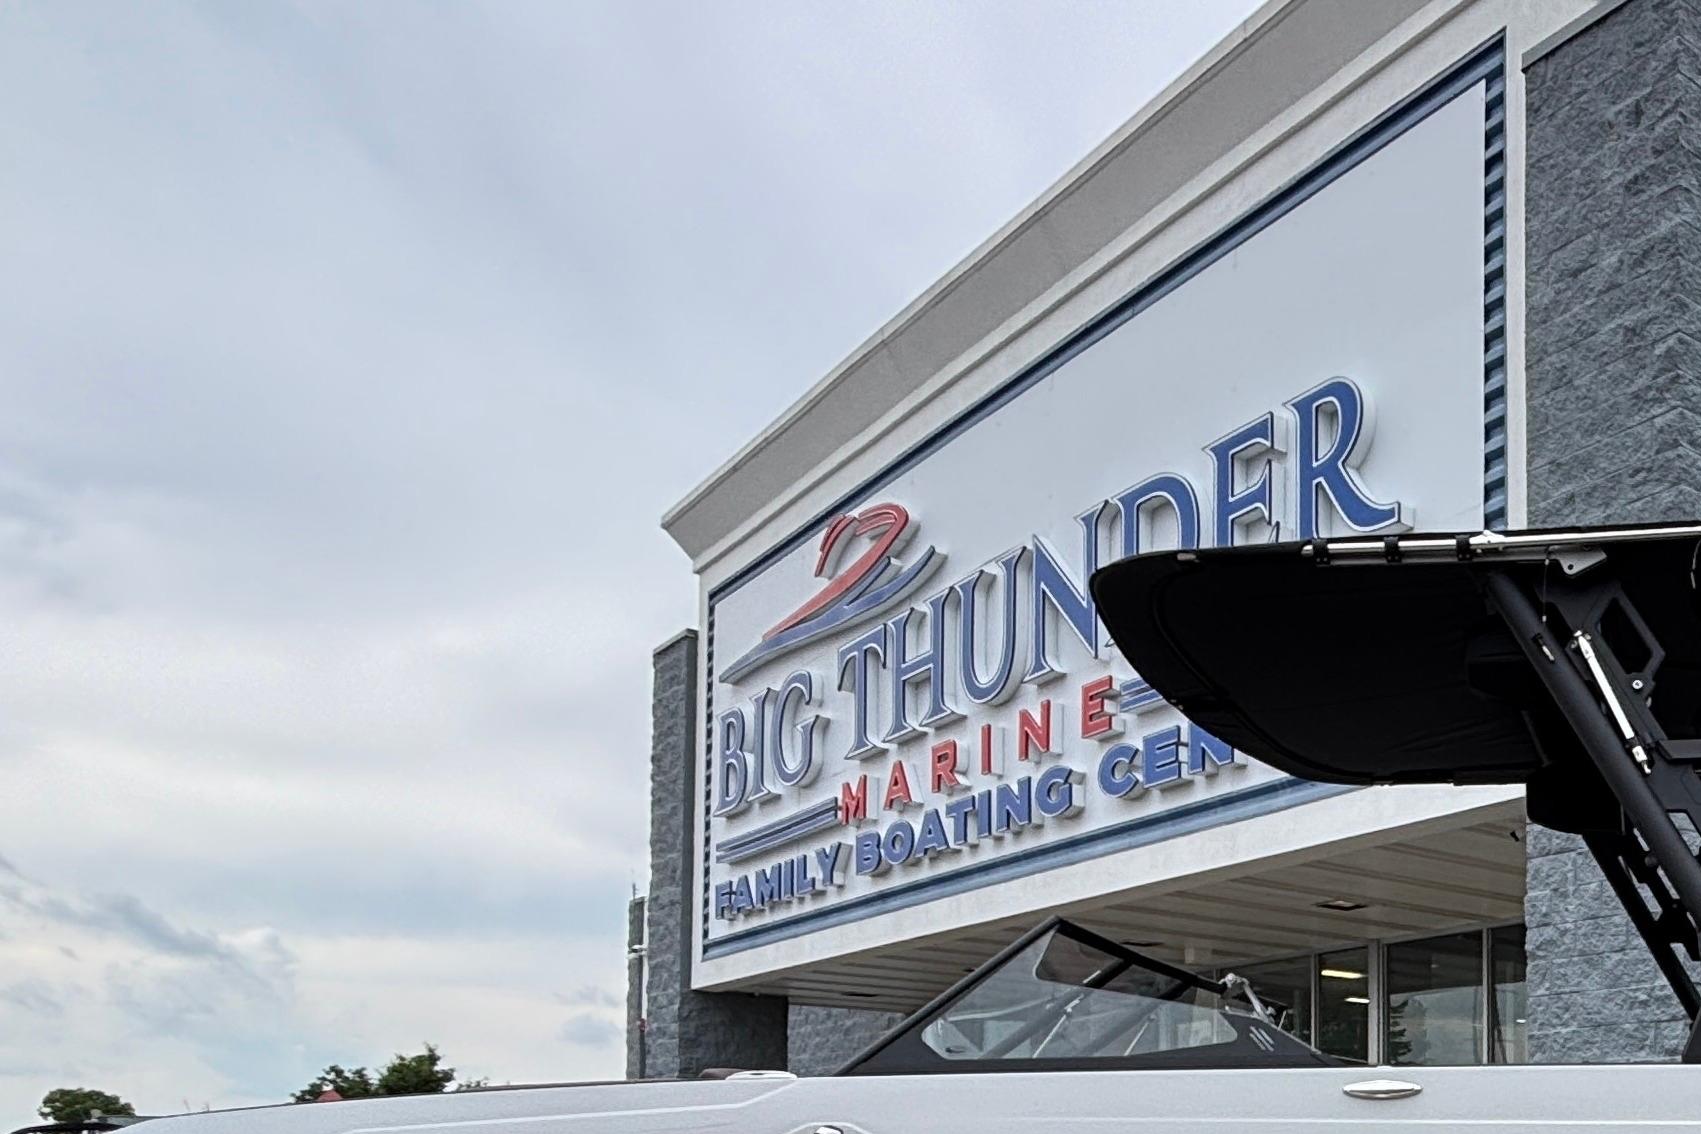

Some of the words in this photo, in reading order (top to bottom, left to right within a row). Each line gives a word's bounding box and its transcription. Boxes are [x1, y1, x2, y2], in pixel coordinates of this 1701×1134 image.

[714, 670, 822, 818] BIG
[840, 674, 1114, 826] MARINE
[715, 842, 843, 920] FAMILY
[855, 768, 1074, 876] BOATING
